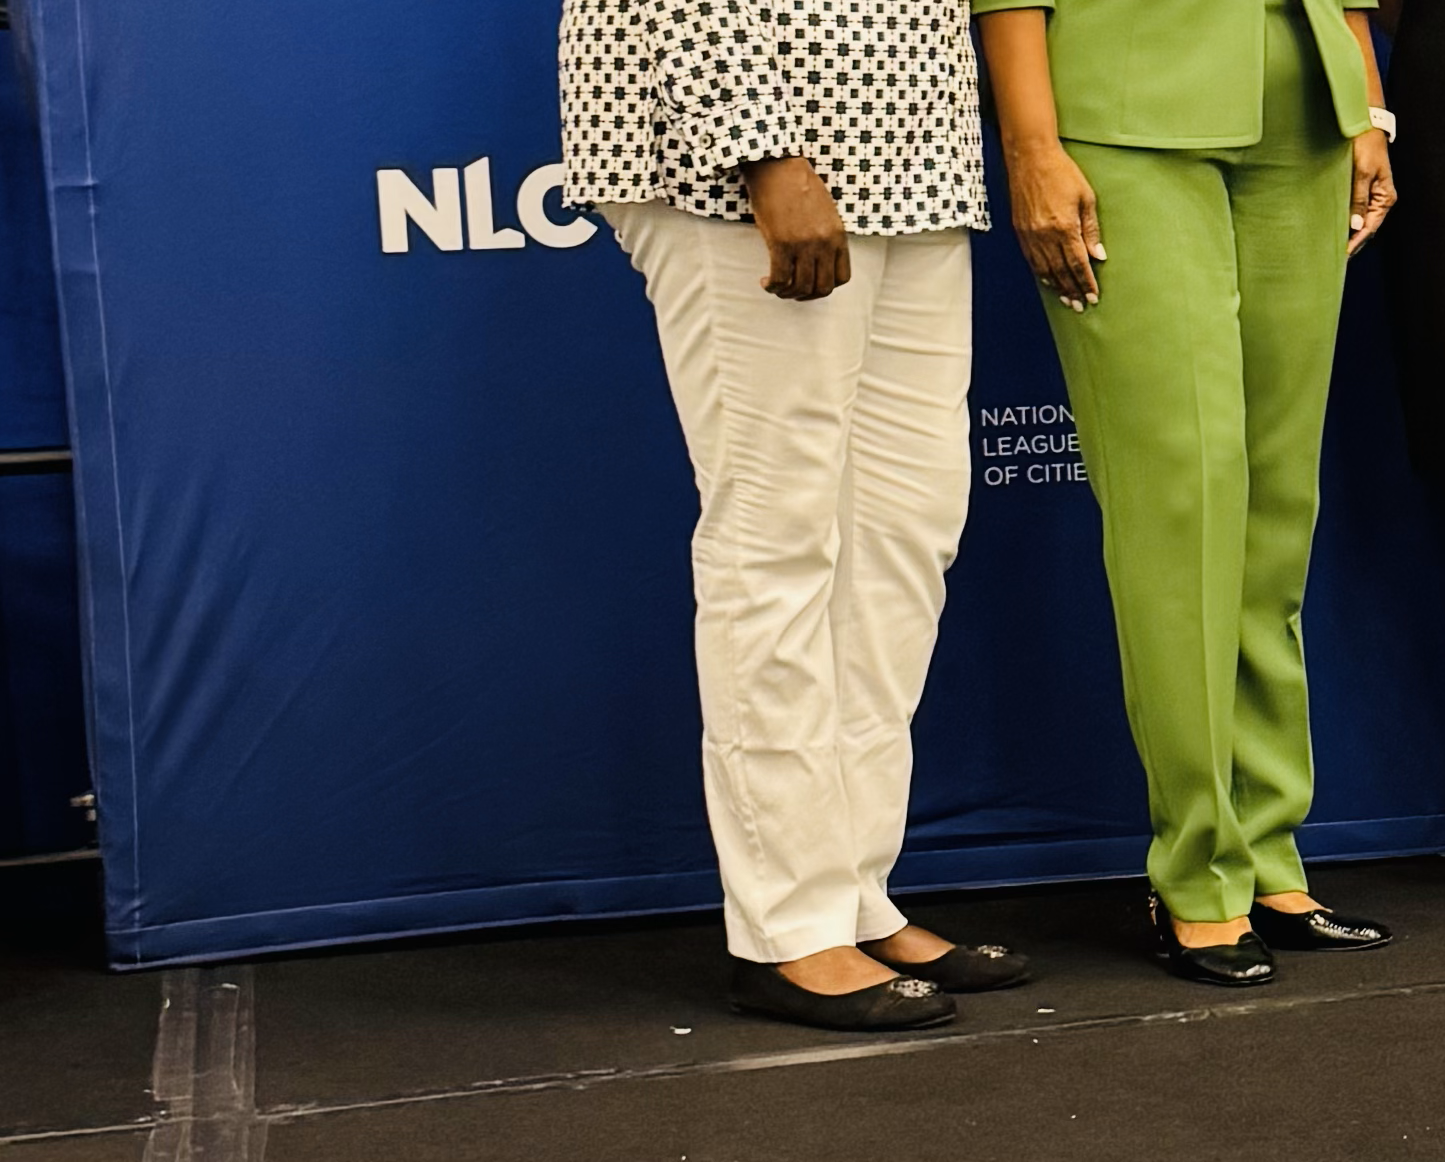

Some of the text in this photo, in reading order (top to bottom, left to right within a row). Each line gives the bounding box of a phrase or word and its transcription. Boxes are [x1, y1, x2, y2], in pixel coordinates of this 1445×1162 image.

[981, 404, 1075, 427] NATION
[984, 462, 1087, 486] OF CITIE
